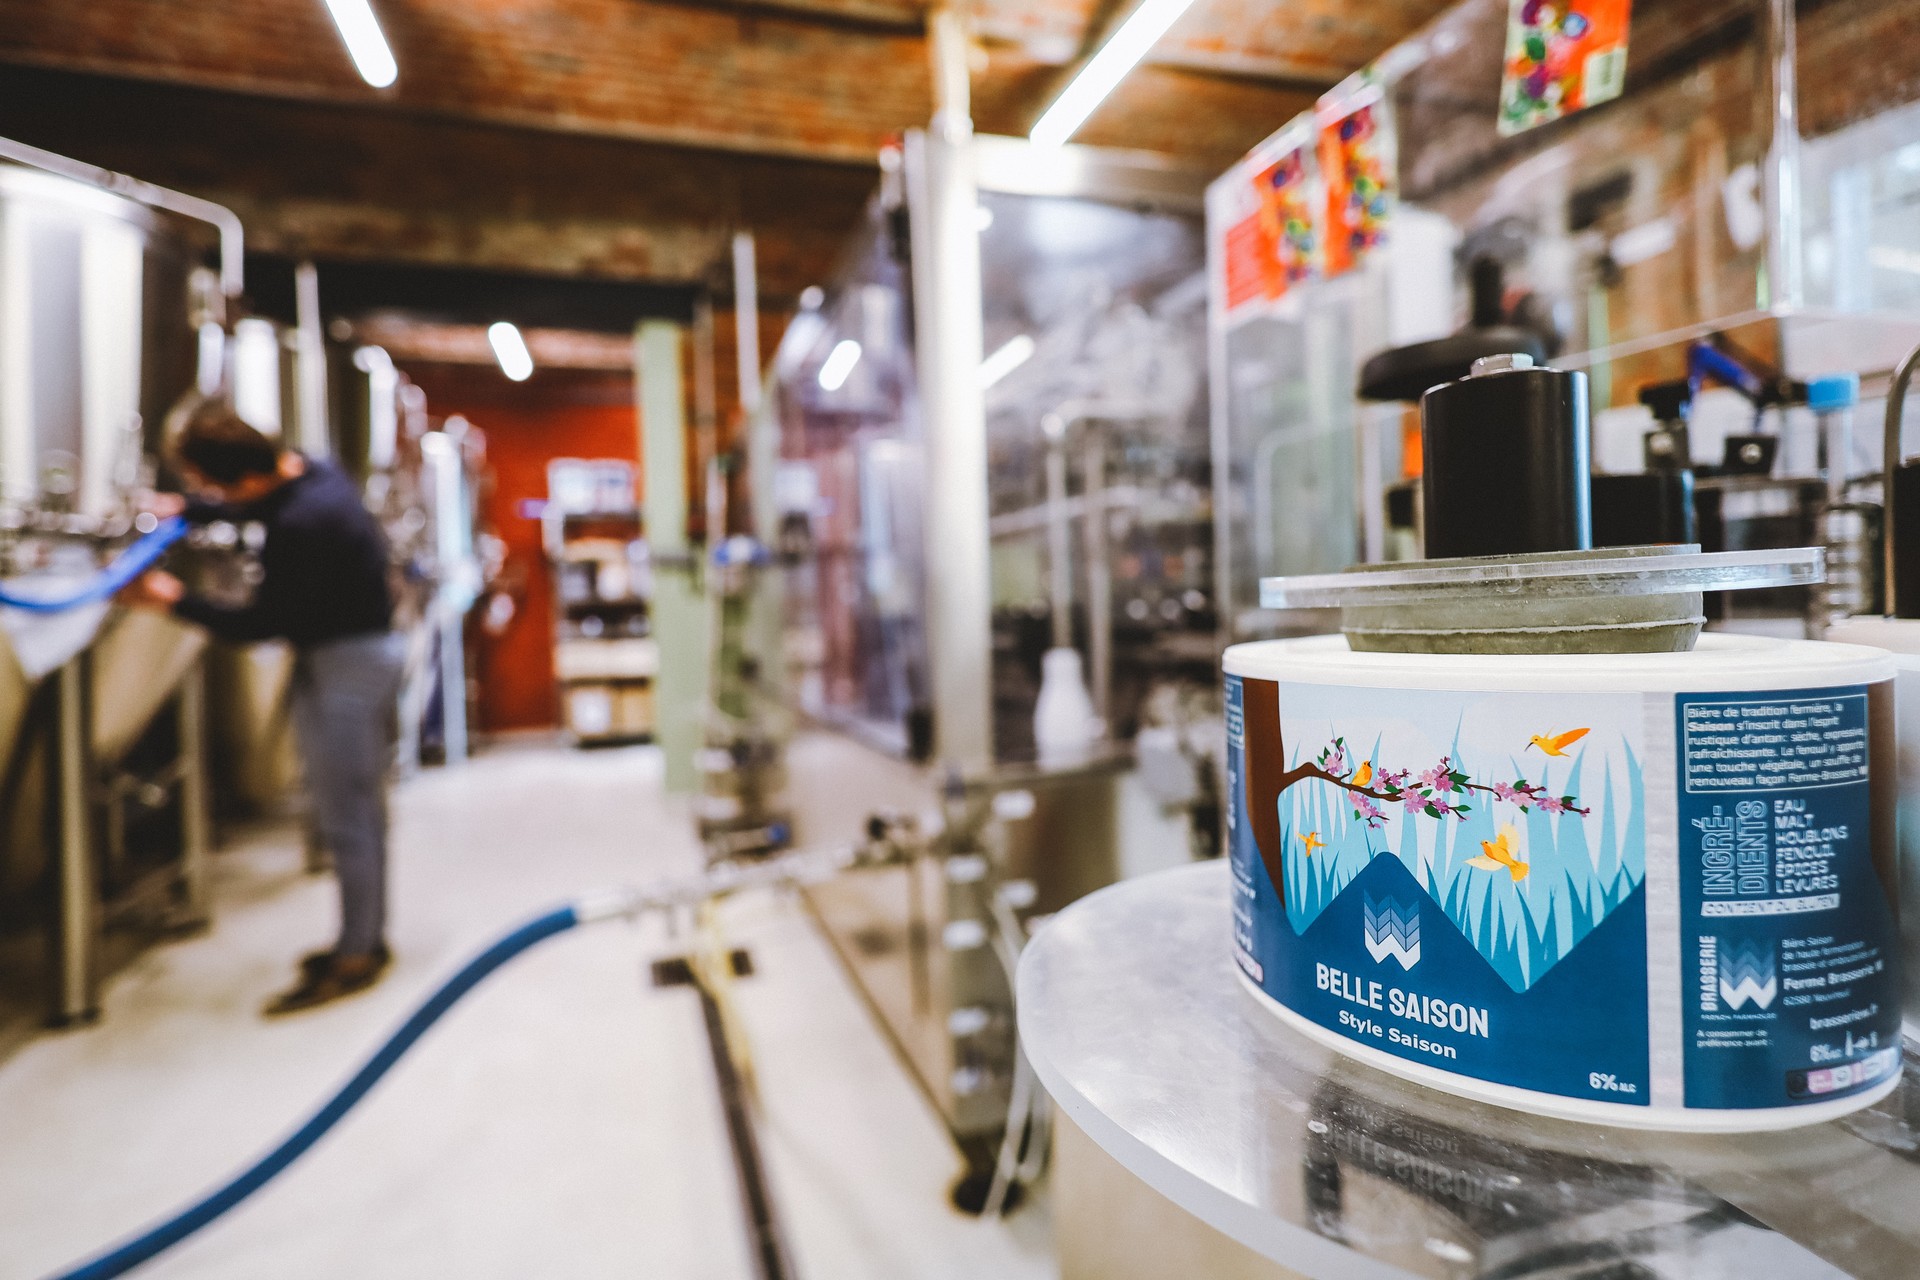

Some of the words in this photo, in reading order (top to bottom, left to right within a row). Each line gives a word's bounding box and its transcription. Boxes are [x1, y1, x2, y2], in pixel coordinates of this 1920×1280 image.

[1688, 707, 1720, 718] Bière
[1723, 707, 1739, 718] de
[1741, 706, 1788, 717] tradition
[1688, 721, 1735, 732] Saison
[1736, 719, 1781, 731] s'inscrit
[1782, 719, 1807, 729] dans
[1688, 735, 1740, 747] rustique
[1689, 747, 1778, 759] rafraîchissante.
[1781, 746, 1795, 756] Le
[1690, 764, 1713, 773] une
[1715, 762, 1757, 773] touche
[1809, 759, 1822, 768] un
[1690, 777, 1754, 786] renouveau
[1756, 774, 1787, 787] façon
[1774, 799, 1806, 813] EAU
[1774, 813, 1815, 830] MALT
[1775, 825, 1849, 845] HOUBLONS
[1692, 805, 1736, 895] INGRÉ-
[1735, 800, 1769, 894] DIENTS
[1775, 844, 1836, 861] FENOUIL
[1775, 859, 1829, 877] ÉPICES
[1775, 874, 1839, 894] LEVURES
[1699, 935, 1718, 1011] BRASSERIE
[1315, 961, 1383, 1011] BELLE
[1389, 987, 1489, 1040] SAISON
[1338, 1009, 1384, 1038] Style
[1388, 1027, 1457, 1060] Saison
[1588, 1071, 1619, 1092] 6%
